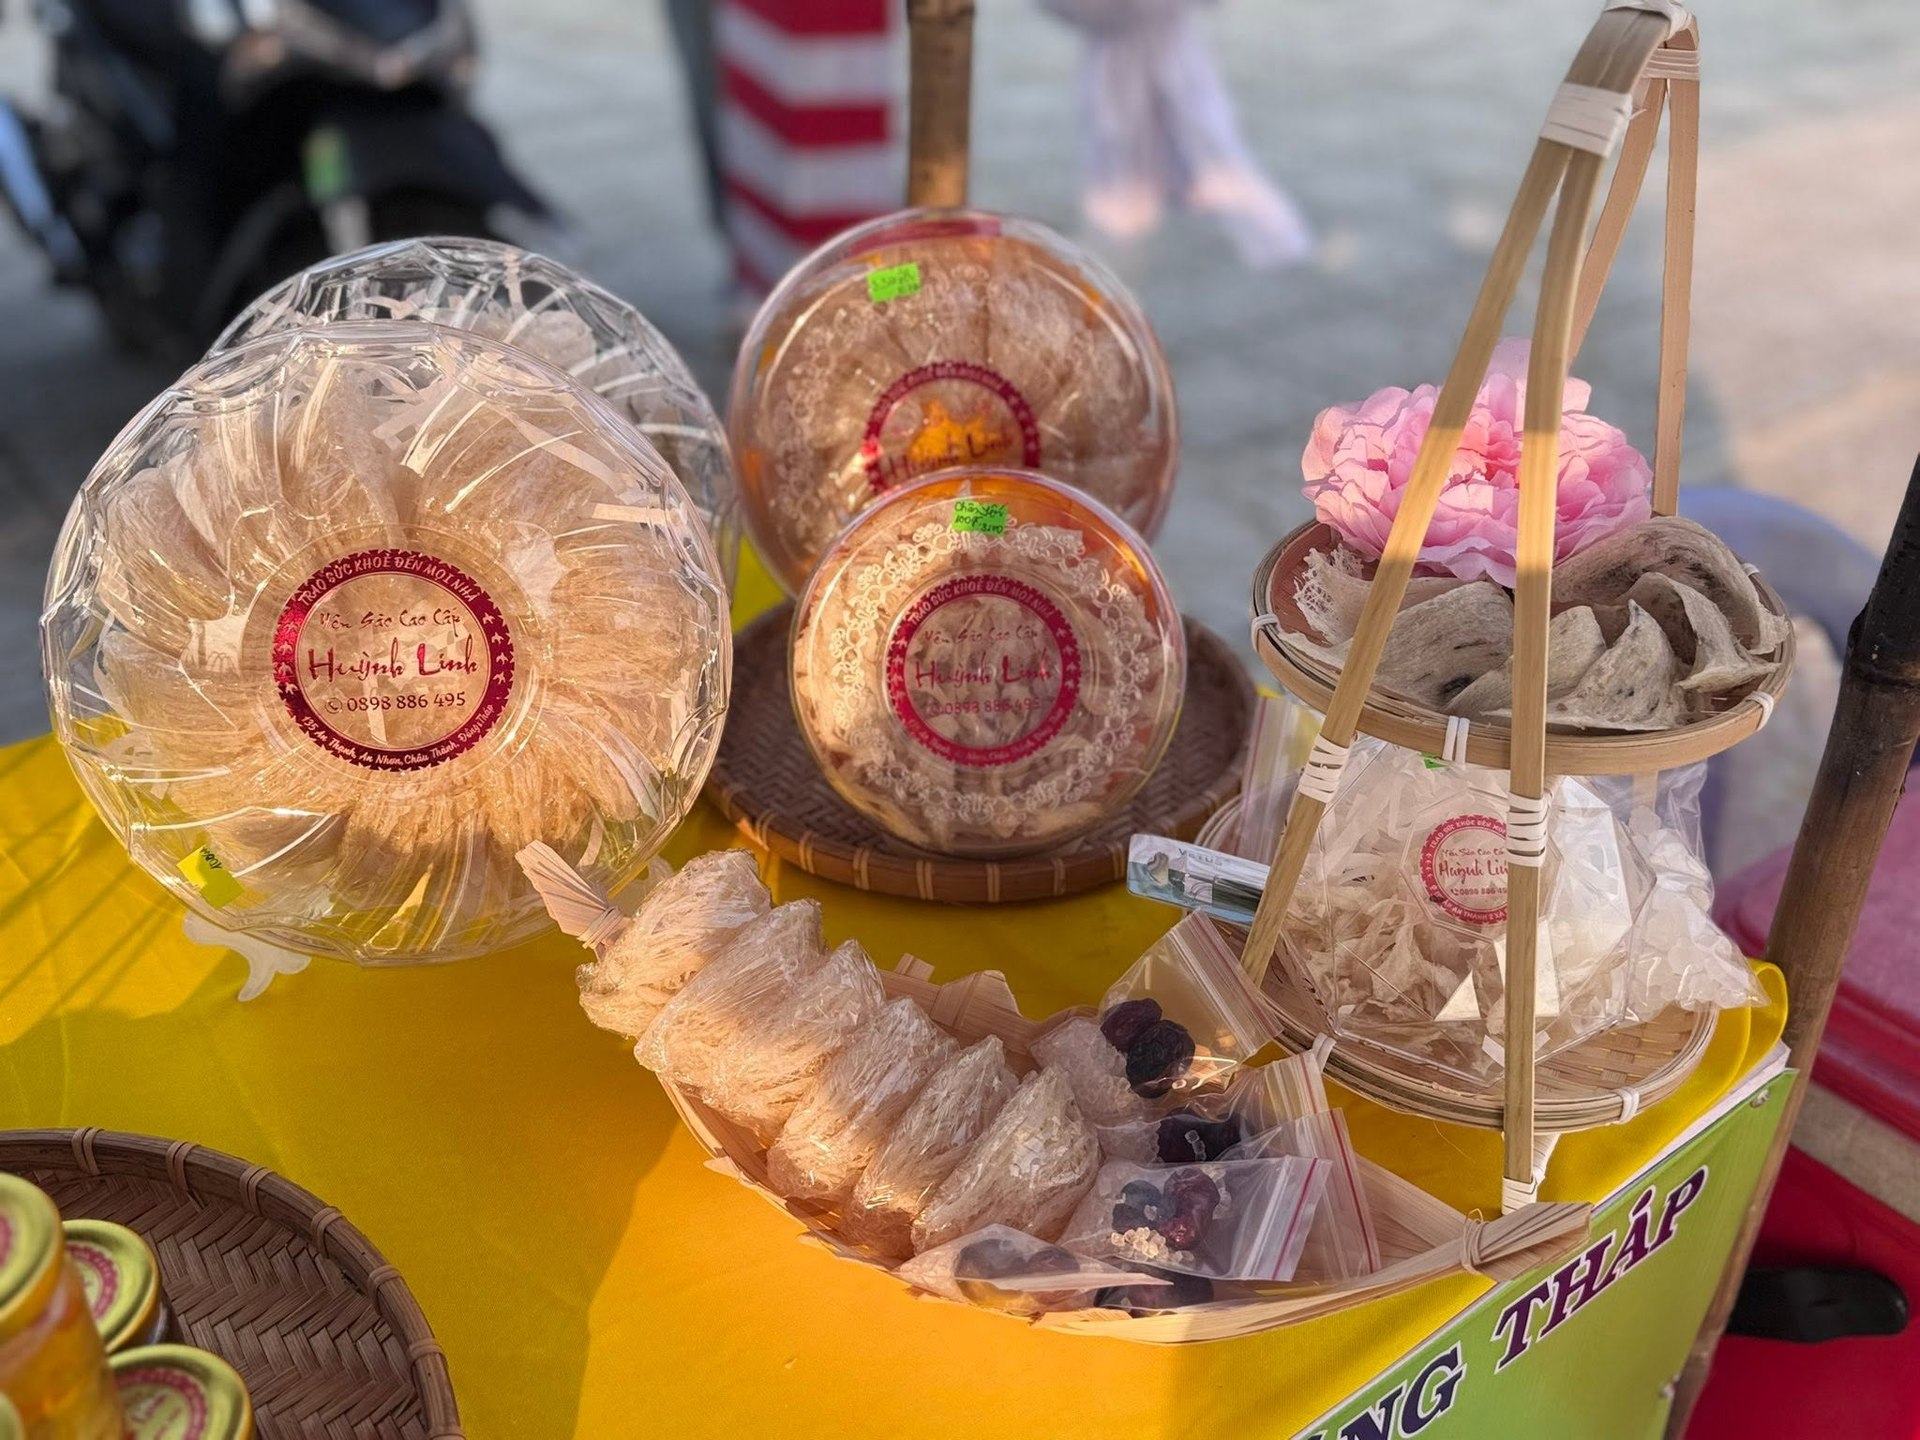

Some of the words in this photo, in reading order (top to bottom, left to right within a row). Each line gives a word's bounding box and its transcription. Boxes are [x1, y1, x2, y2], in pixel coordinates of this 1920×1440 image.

[299, 578, 328, 606] TRAO
[326, 563, 354, 584] SỨC
[393, 554, 424, 571] ĐẾN
[424, 565, 454, 585] MỌI
[399, 609, 426, 627] Cao
[433, 607, 461, 637] Cấp
[908, 601, 932, 625] TRAO
[308, 637, 405, 683] Huỳnh
[416, 634, 479, 676] Linh
[915, 650, 991, 689] Huỳnh
[1002, 647, 1052, 683] Linh
[347, 695, 391, 712] 0898
[396, 694, 428, 709] 886
[434, 691, 466, 708] 495
[301, 716, 319, 731] 135
[313, 730, 328, 742] An
[358, 751, 374, 763] An
[404, 752, 430, 765] Châu
[1439, 859, 1483, 885] Huỳnh
[1487, 859, 1508, 876] Lin
[1307, 1342, 1466, 1440] NG
[1491, 1165, 1709, 1374] THÁP
